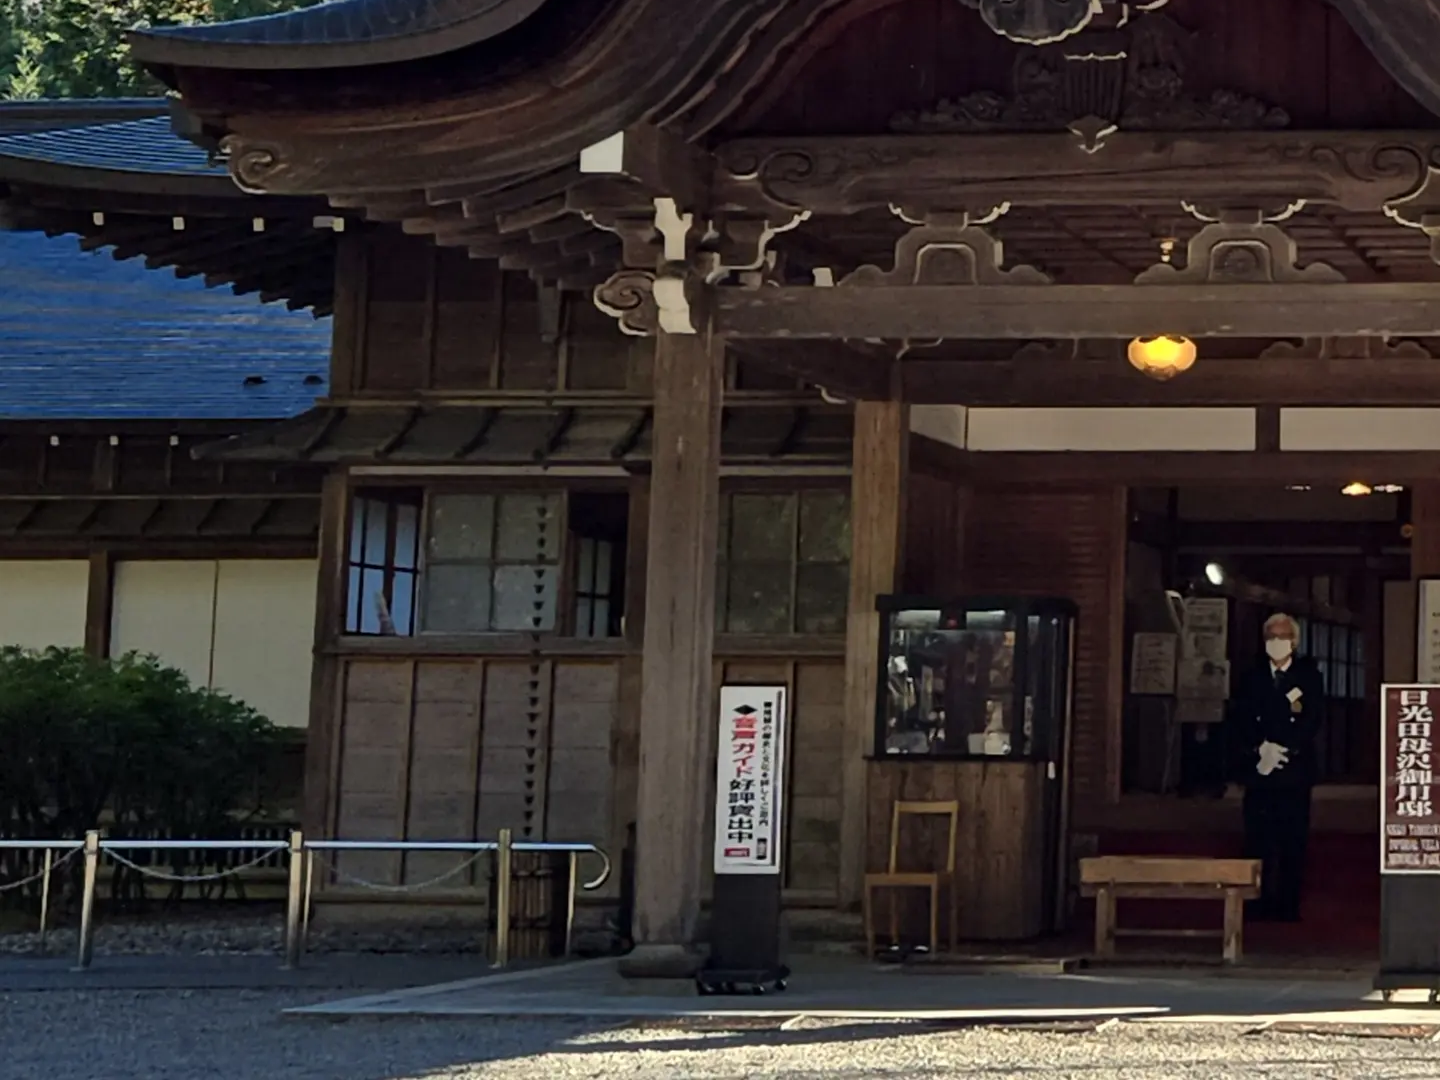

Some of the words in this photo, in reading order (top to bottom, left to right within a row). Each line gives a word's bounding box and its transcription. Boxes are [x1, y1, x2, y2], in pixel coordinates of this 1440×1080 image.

[727, 716, 757, 843] 音声ガイド好評貸出中
[1395, 690, 1433, 817] 日光田母沢御用邸
